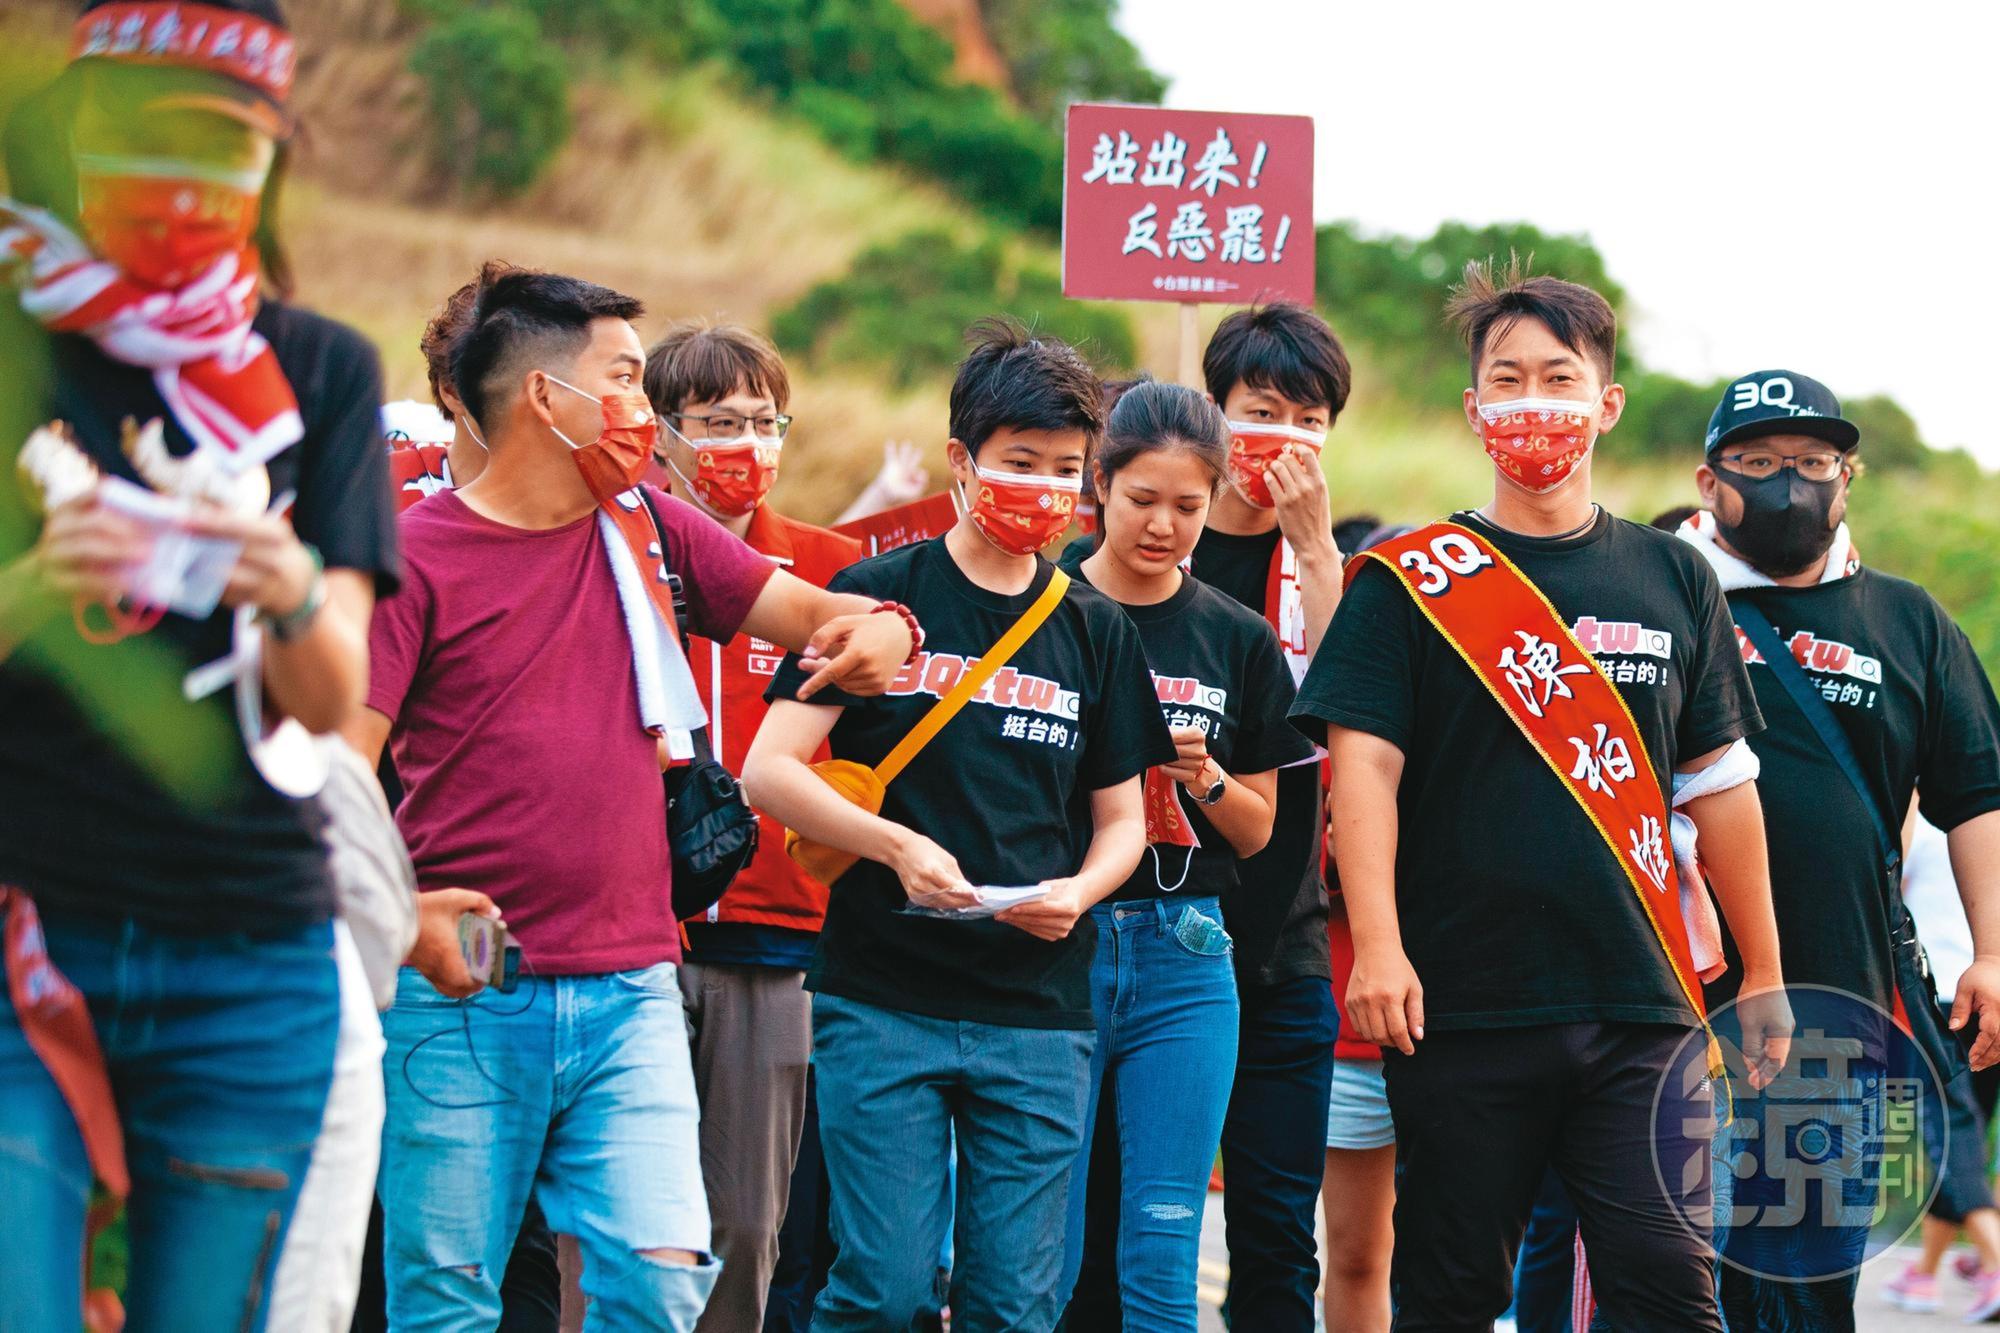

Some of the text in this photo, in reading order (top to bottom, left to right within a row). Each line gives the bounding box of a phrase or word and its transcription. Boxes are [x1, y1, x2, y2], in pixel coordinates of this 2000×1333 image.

[1122, 200, 1290, 264] 反惡罷!
[1733, 377, 1794, 411] 3Q
[1525, 434, 1550, 452] 3Q
[1051, 492, 1072, 513] 3Q
[1400, 533, 1493, 595] 3Q
[1002, 713, 1078, 750] 挺台的!
